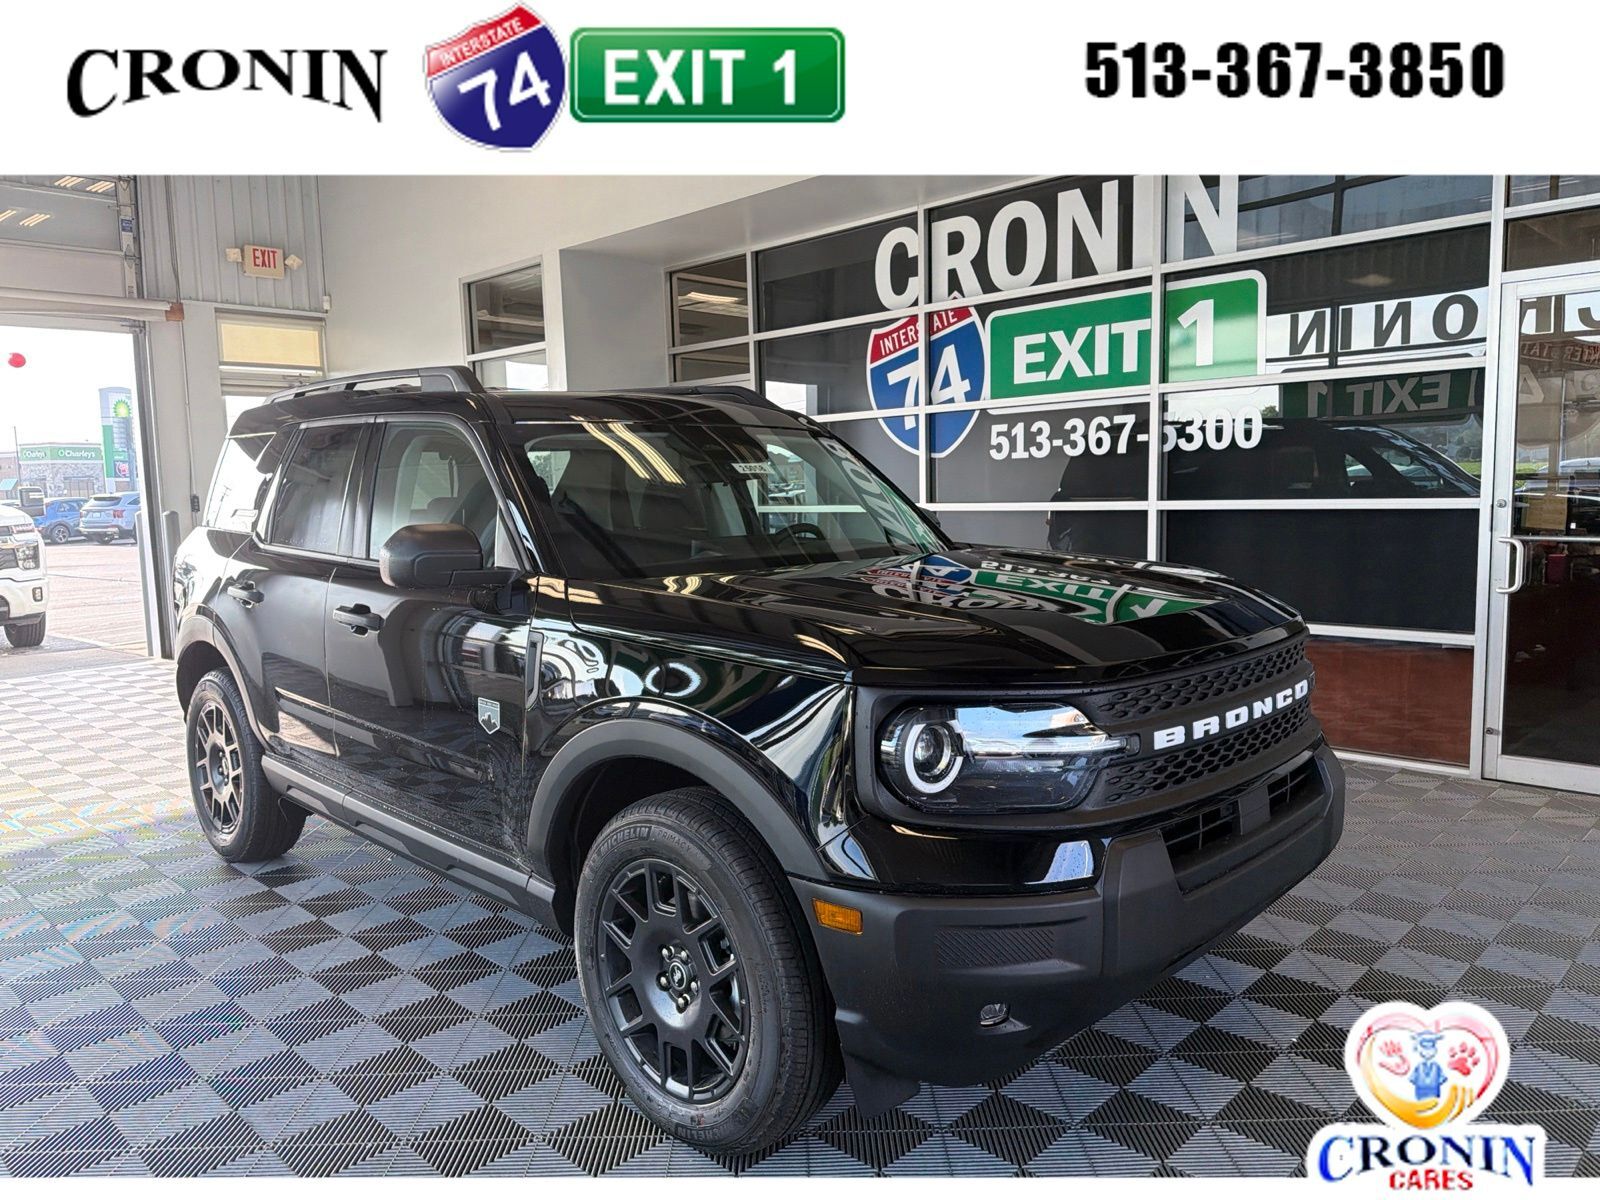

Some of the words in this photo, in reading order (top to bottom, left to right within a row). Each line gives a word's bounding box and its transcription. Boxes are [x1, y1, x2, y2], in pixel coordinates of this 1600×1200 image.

[252, 248, 278, 269] EXIT
[875, 174, 1239, 311] CRONIN
[1013, 318, 1152, 384] EXIT
[1176, 299, 1215, 366] 1
[886, 343, 971, 431] 74
[1154, 679, 1308, 750] BRONCO
[600, 826, 650, 854] MICHELIN
